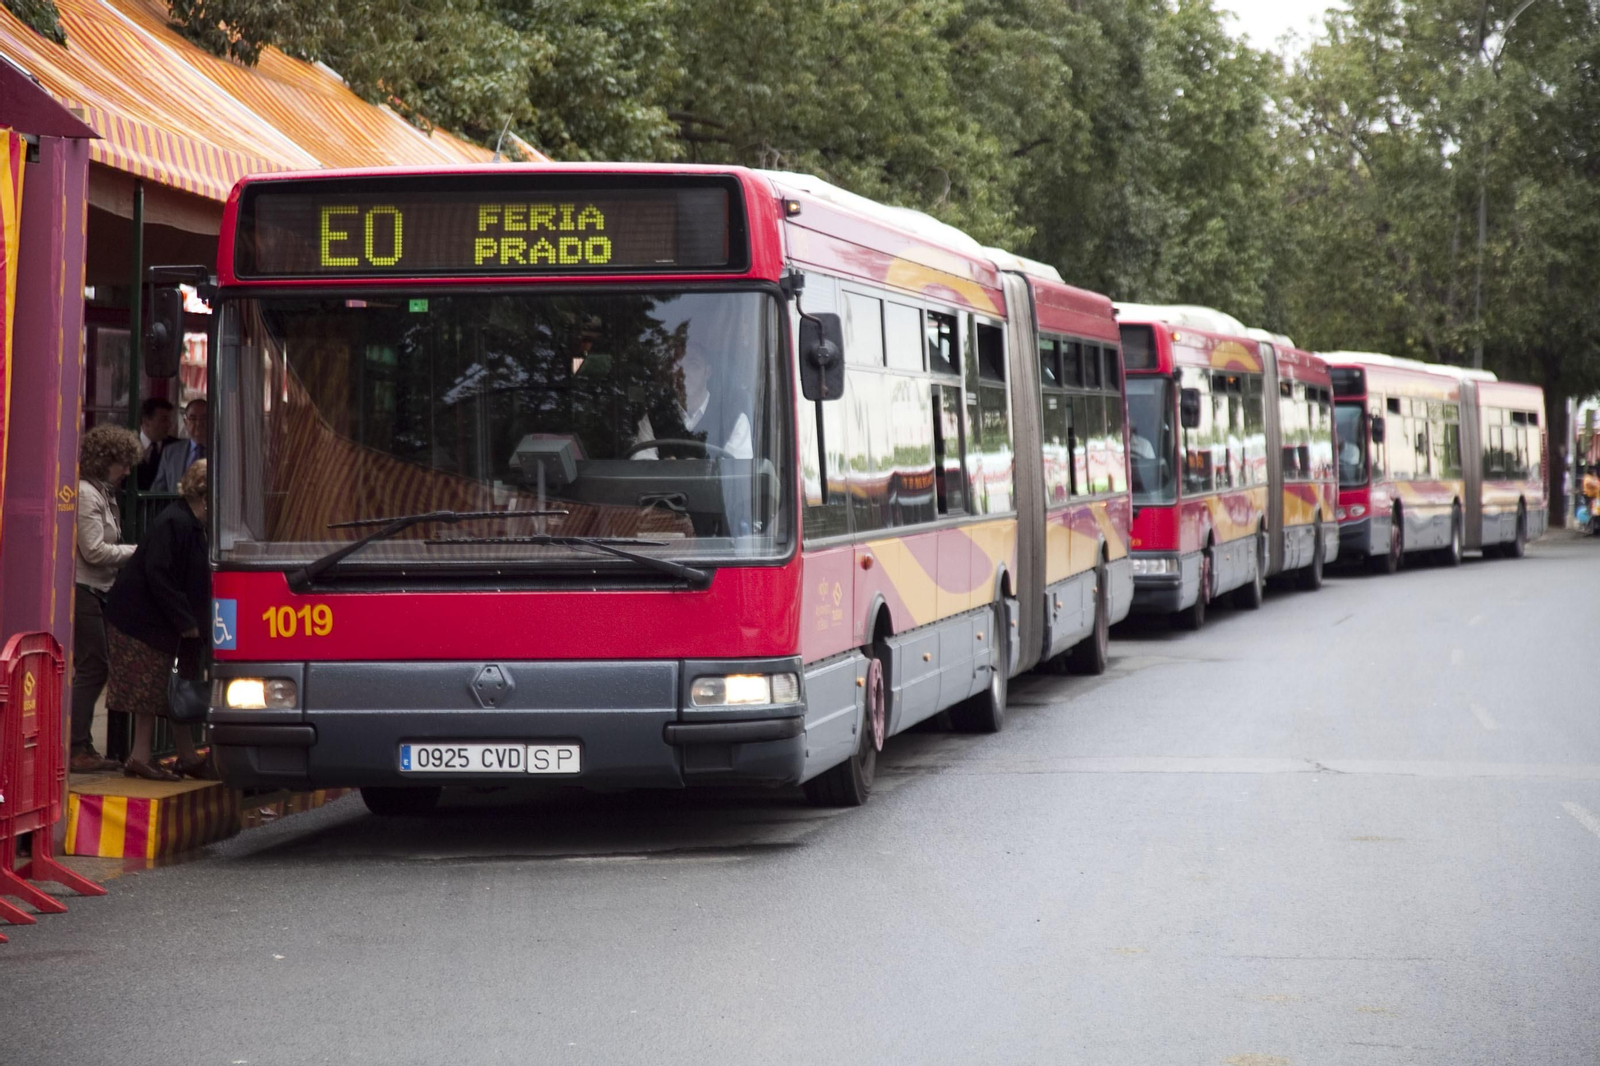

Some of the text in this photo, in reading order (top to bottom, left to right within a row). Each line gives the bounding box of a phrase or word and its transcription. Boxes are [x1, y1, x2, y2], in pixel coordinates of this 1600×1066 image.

[478, 204, 605, 232] FERIA
[474, 236, 612, 265] PRADO
[262, 604, 333, 638] 1019
[418, 748, 520, 768] 0925 CVD
